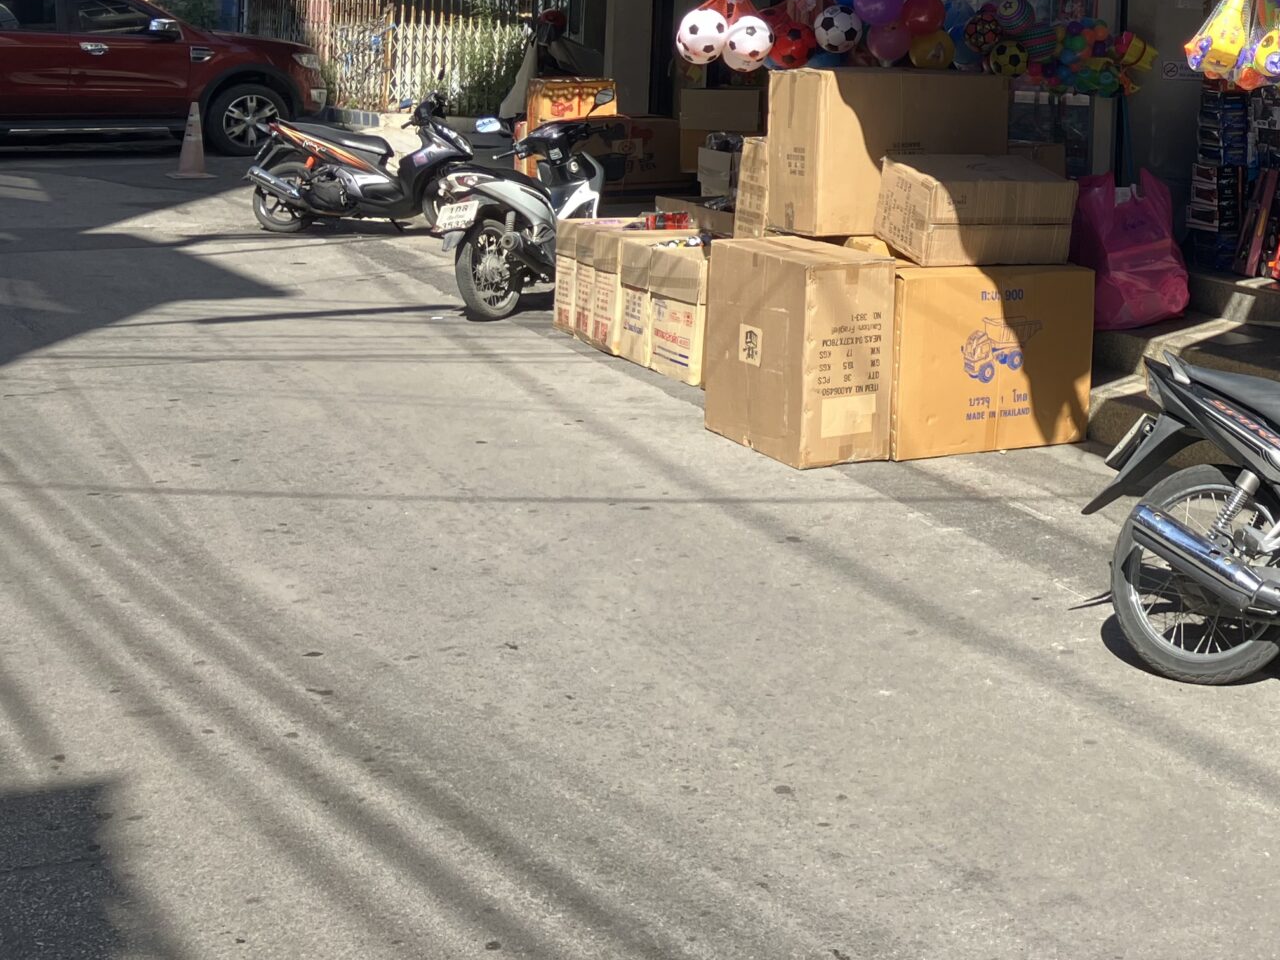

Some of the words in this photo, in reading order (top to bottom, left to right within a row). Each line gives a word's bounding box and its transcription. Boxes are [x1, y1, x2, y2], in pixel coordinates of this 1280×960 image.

[1005, 289, 1024, 300] 900
[819, 351, 831, 359] KGS
[846, 349, 853, 357] 17
[817, 376, 830, 385] PCS
[865, 384, 879, 392] ITEM
[969, 396, 991, 408] บรรจุ
[966, 412, 985, 421] MADE
[989, 411, 996, 419] IN
[1000, 407, 1031, 418] THAILAND
